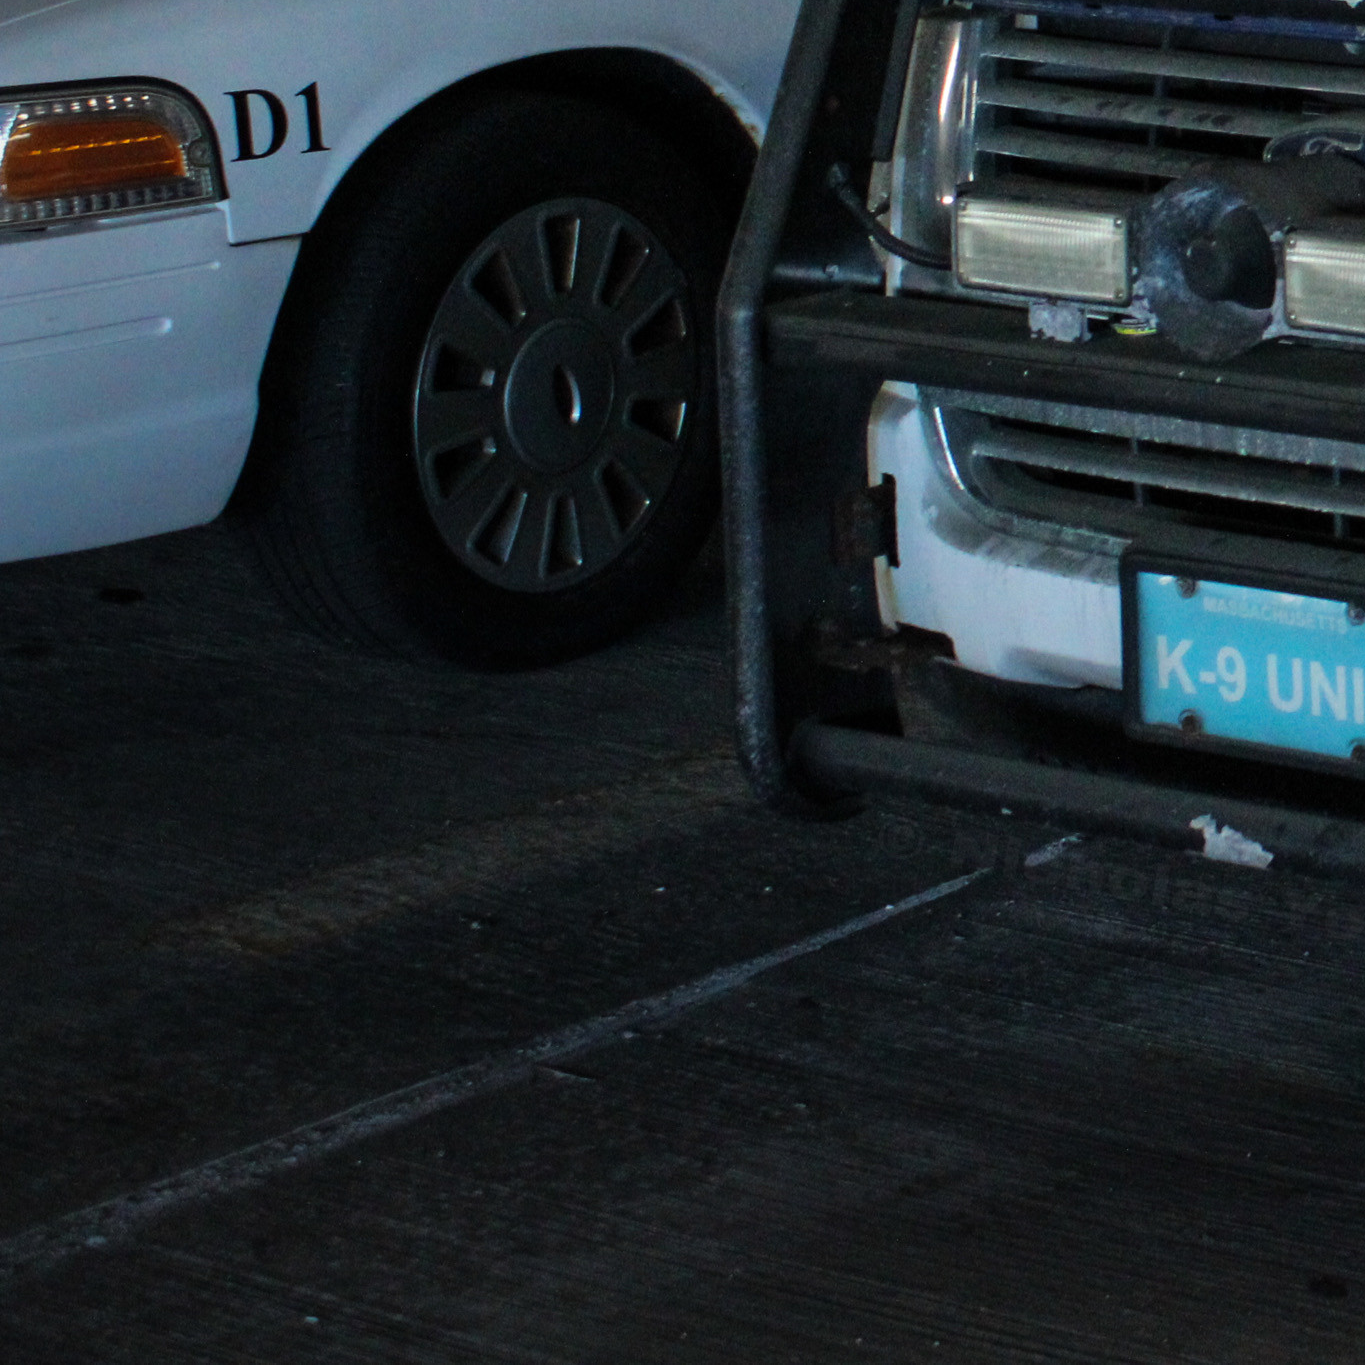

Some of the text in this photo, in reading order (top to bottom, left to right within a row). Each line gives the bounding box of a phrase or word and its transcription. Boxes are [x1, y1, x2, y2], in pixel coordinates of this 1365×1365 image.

[223, 81, 331, 162] D1
[1202, 595, 1349, 635] MASSACHUSETTS
[1156, 635, 1247, 703] K-9
